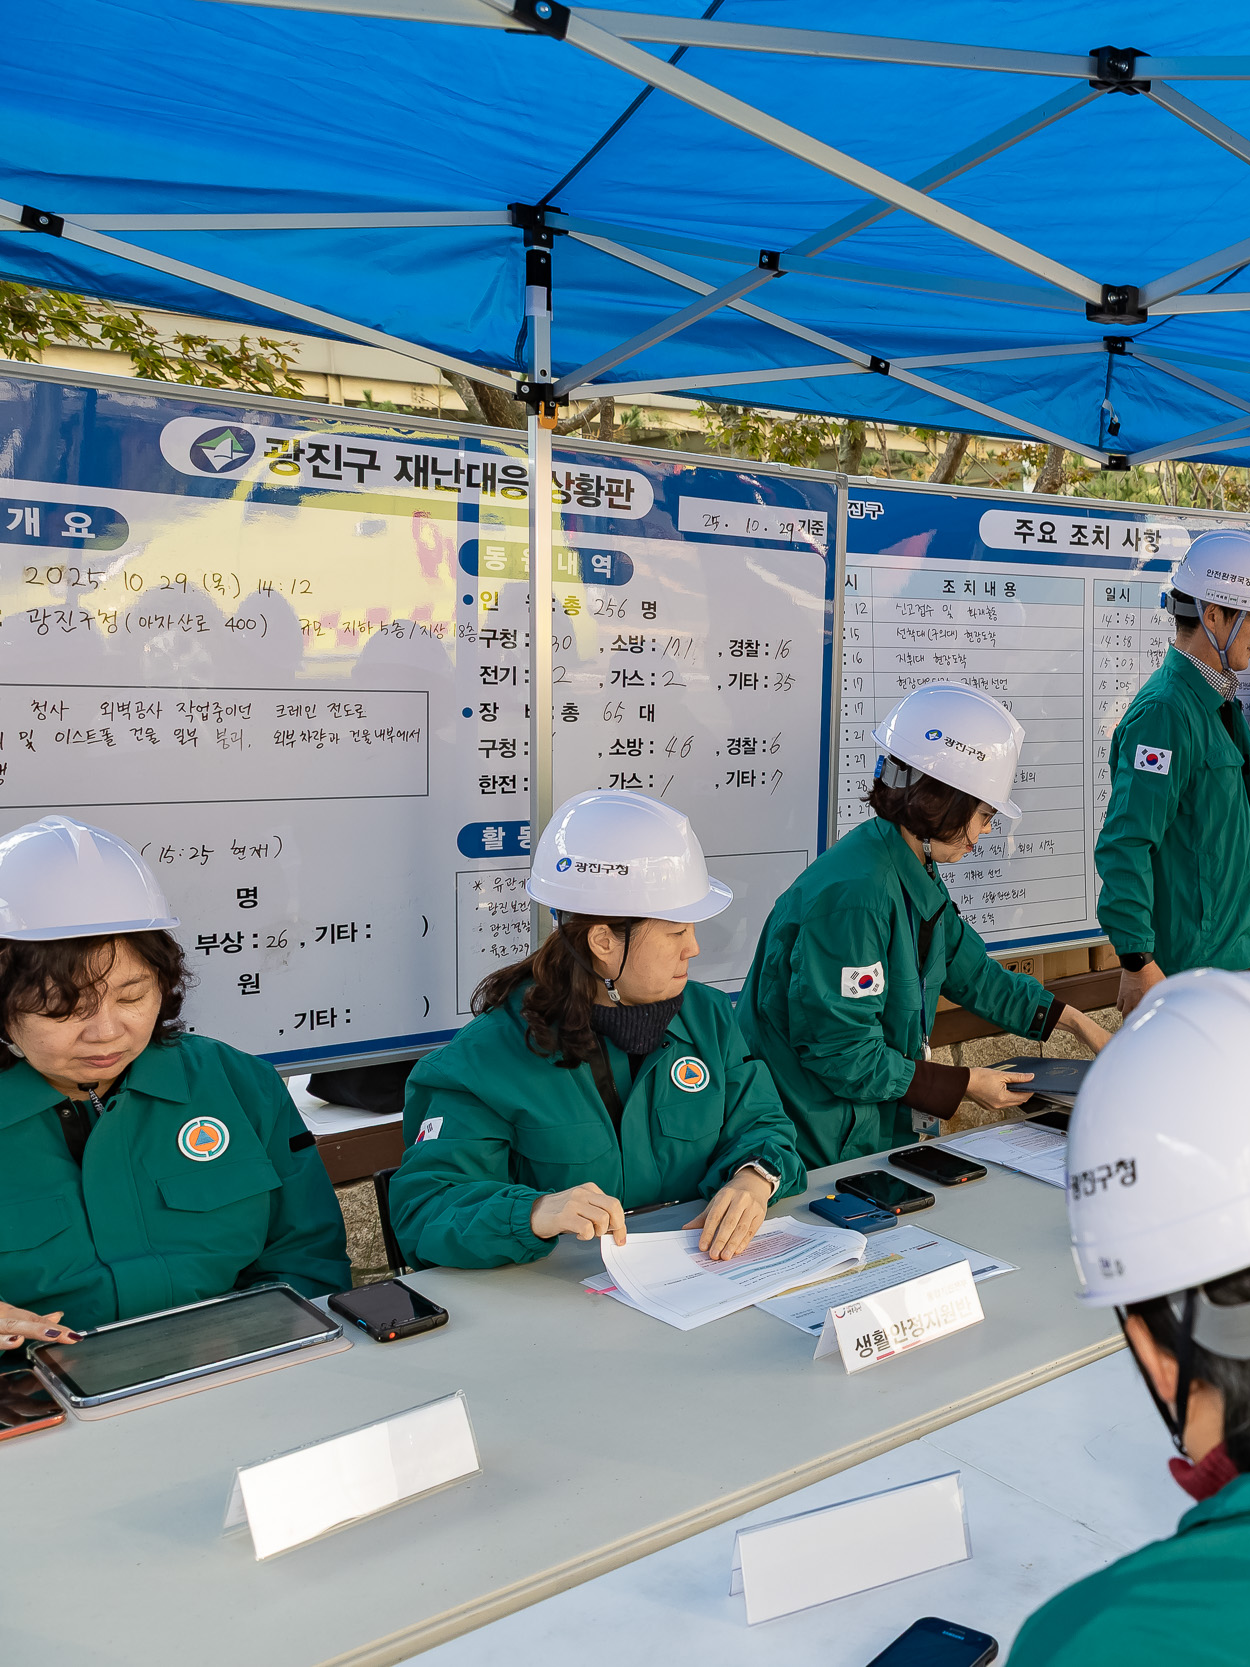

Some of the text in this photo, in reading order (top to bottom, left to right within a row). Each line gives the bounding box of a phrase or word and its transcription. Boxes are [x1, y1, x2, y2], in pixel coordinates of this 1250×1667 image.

[263, 436, 635, 511] 광진구 재난대응 상황판
[799, 518, 826, 537] 기준
[1013, 518, 1162, 553] 주요 조치 사항
[25, 566, 107, 591] 2025.
[257, 578, 314, 596] 14:12
[593, 598, 629, 619] 256
[641, 600, 658, 620] 명
[224, 614, 269, 638] 400)
[773, 639, 792, 661] 16
[662, 669, 687, 688] 2
[773, 673, 797, 693] 35
[31, 700, 70, 722] 청사
[275, 703, 318, 720] 크레인
[561, 702, 581, 722] 총
[602, 701, 626, 723] 65
[639, 703, 656, 722] 대
[18, 729, 37, 753] 및
[173, 728, 199, 748] 일부
[944, 735, 987, 762] 광진구청
[573, 860, 630, 878] 광진구청
[235, 886, 259, 909] 명
[265, 928, 289, 950] 26
[237, 972, 261, 996] 원
